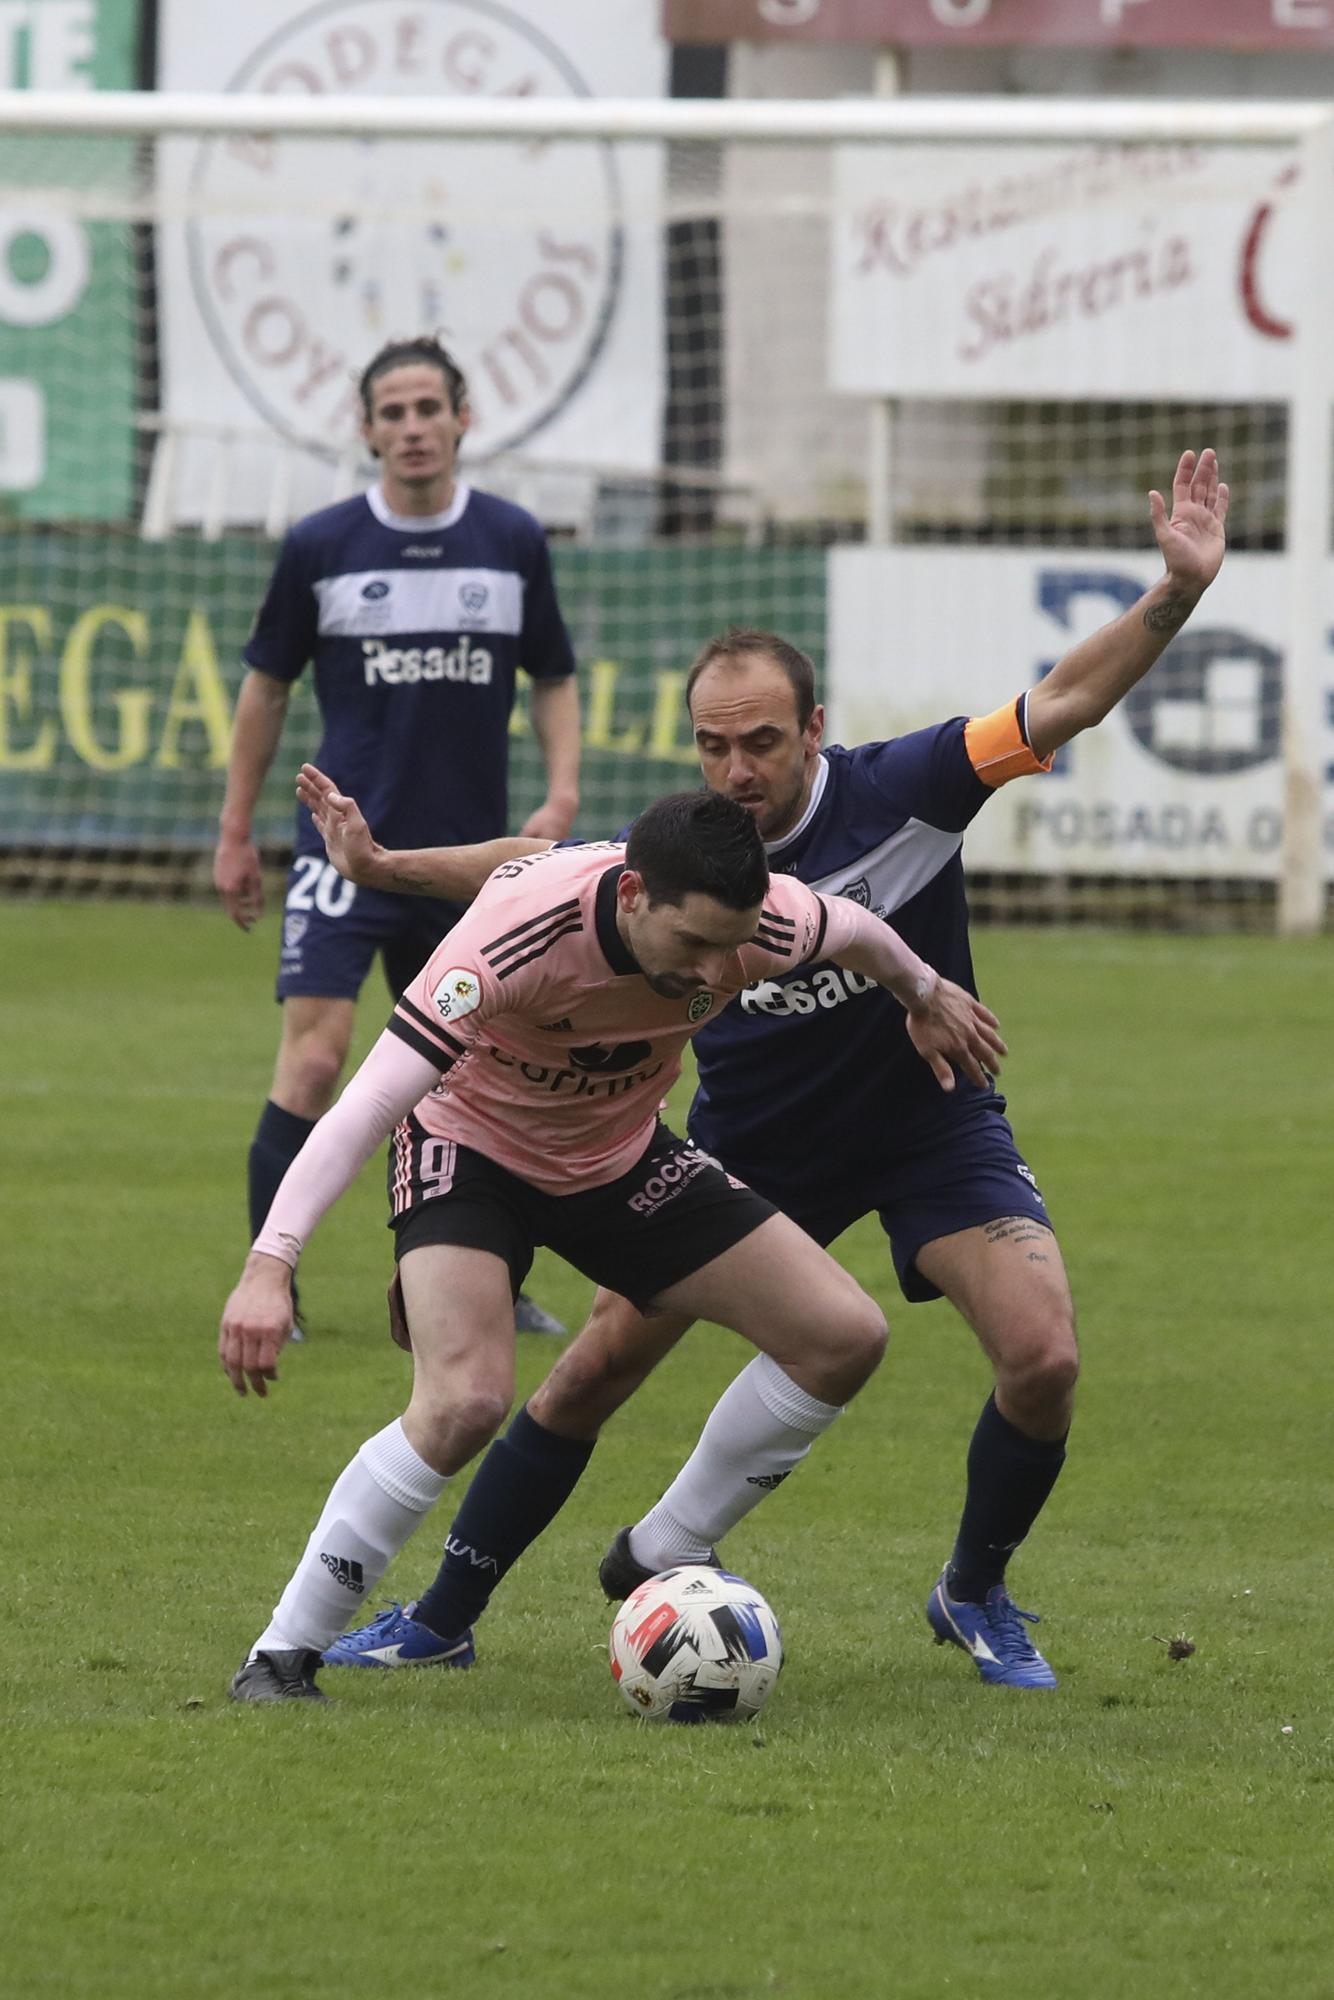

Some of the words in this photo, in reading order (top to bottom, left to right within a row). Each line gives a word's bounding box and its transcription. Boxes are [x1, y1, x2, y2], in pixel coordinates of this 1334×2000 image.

[285, 855, 357, 918] 20
[420, 1137, 457, 1201] 9
[319, 1552, 365, 1595] adidas
